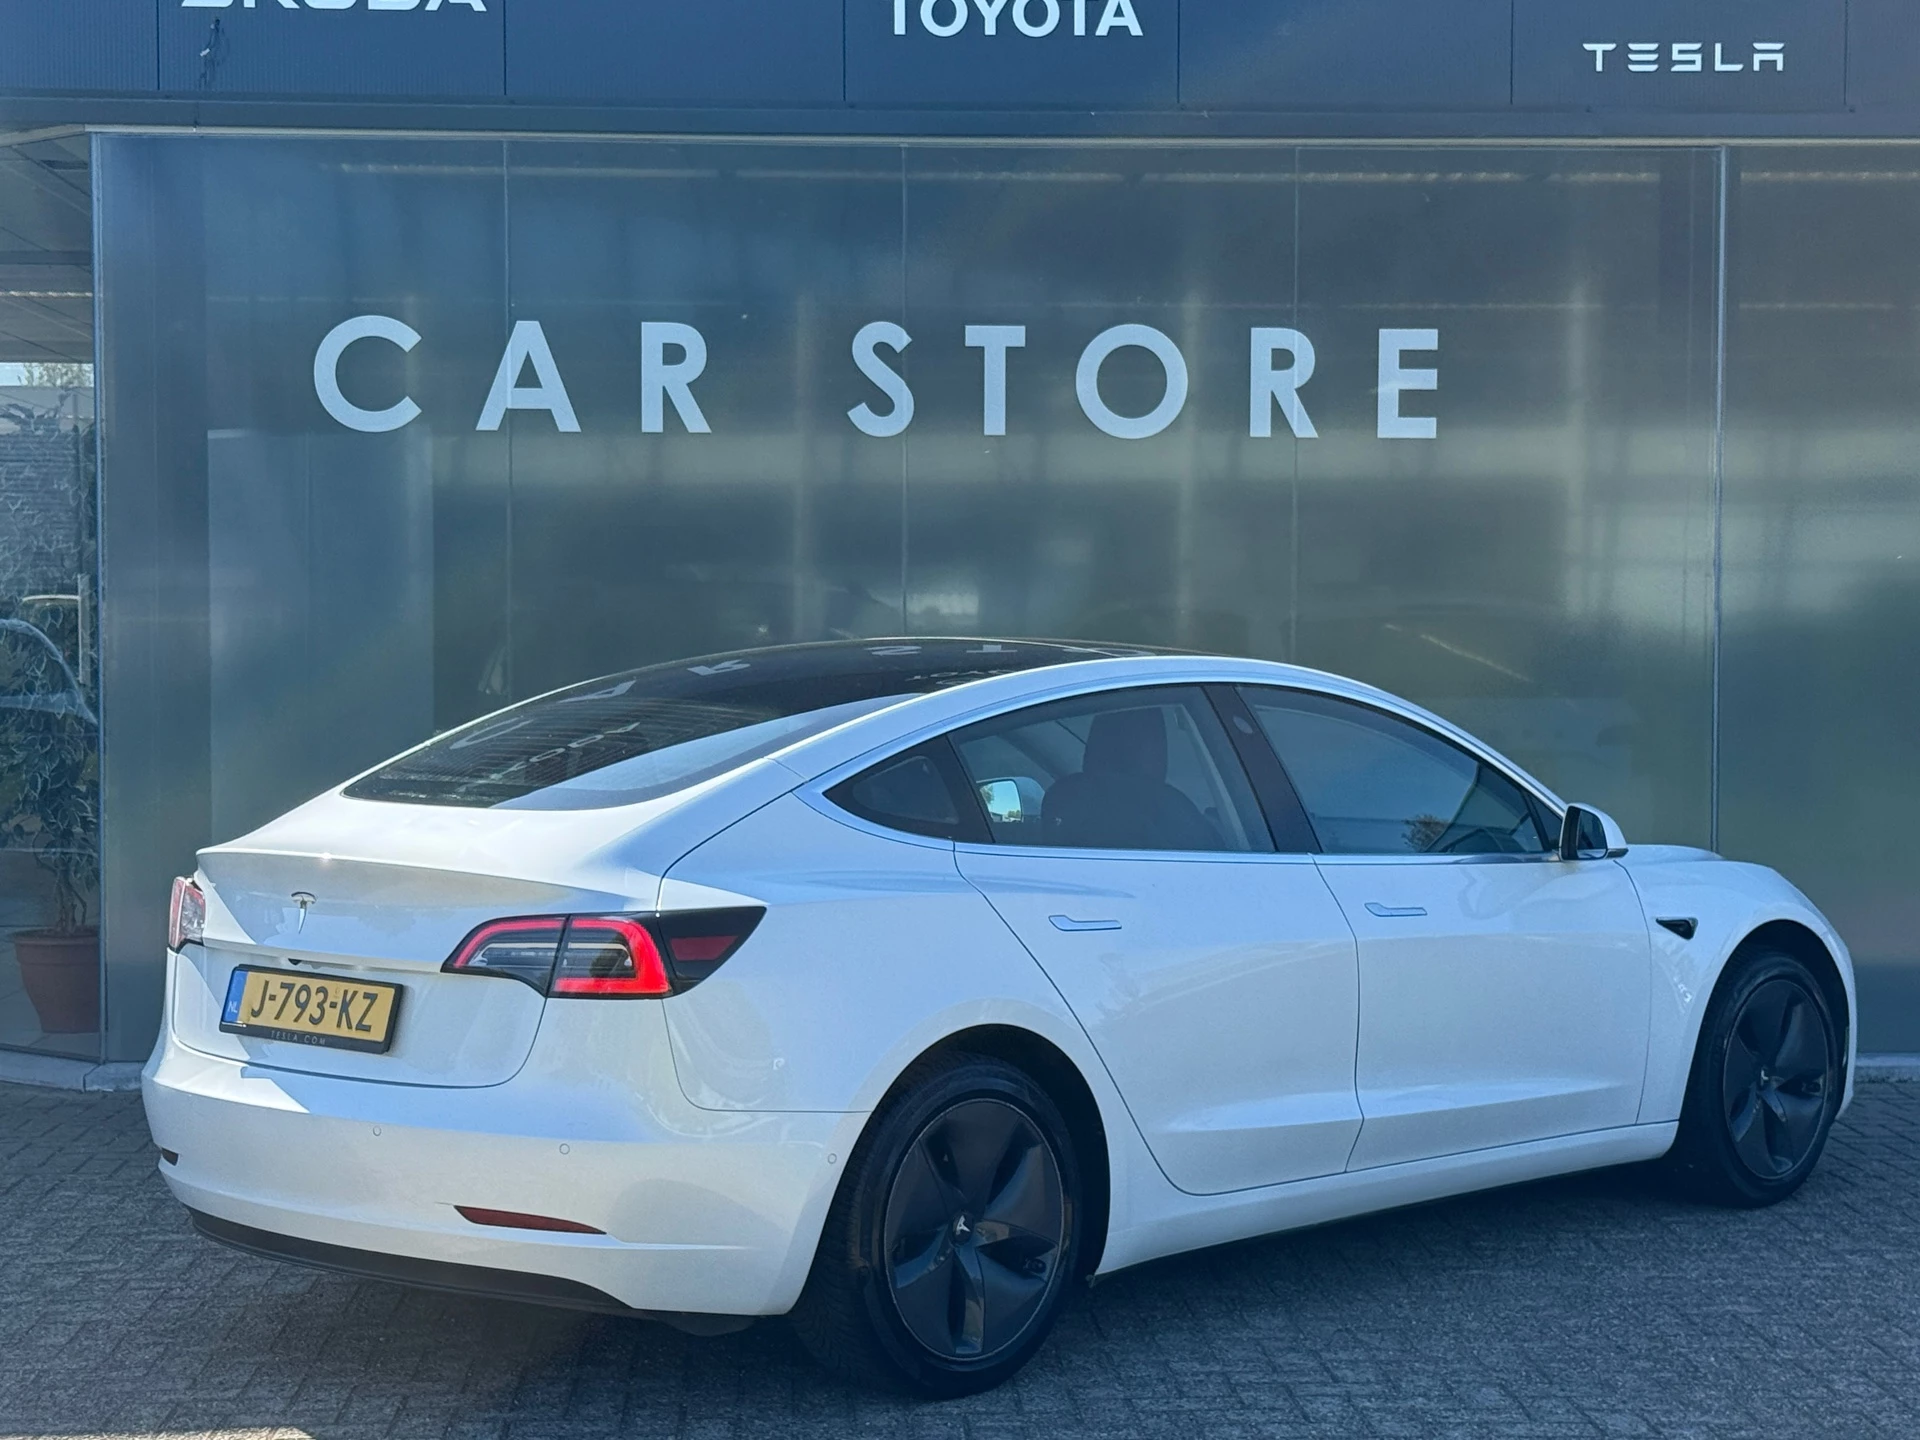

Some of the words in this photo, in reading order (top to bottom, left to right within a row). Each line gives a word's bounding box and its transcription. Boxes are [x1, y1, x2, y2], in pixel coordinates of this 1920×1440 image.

[893, 0, 1144, 38] TOYOTA
[1582, 42, 1785, 72] TESLA
[313, 314, 712, 433] CAR
[847, 321, 1439, 439] STORE
[227, 1000, 238, 1014] NL
[251, 980, 378, 1032] J-793-KZ
